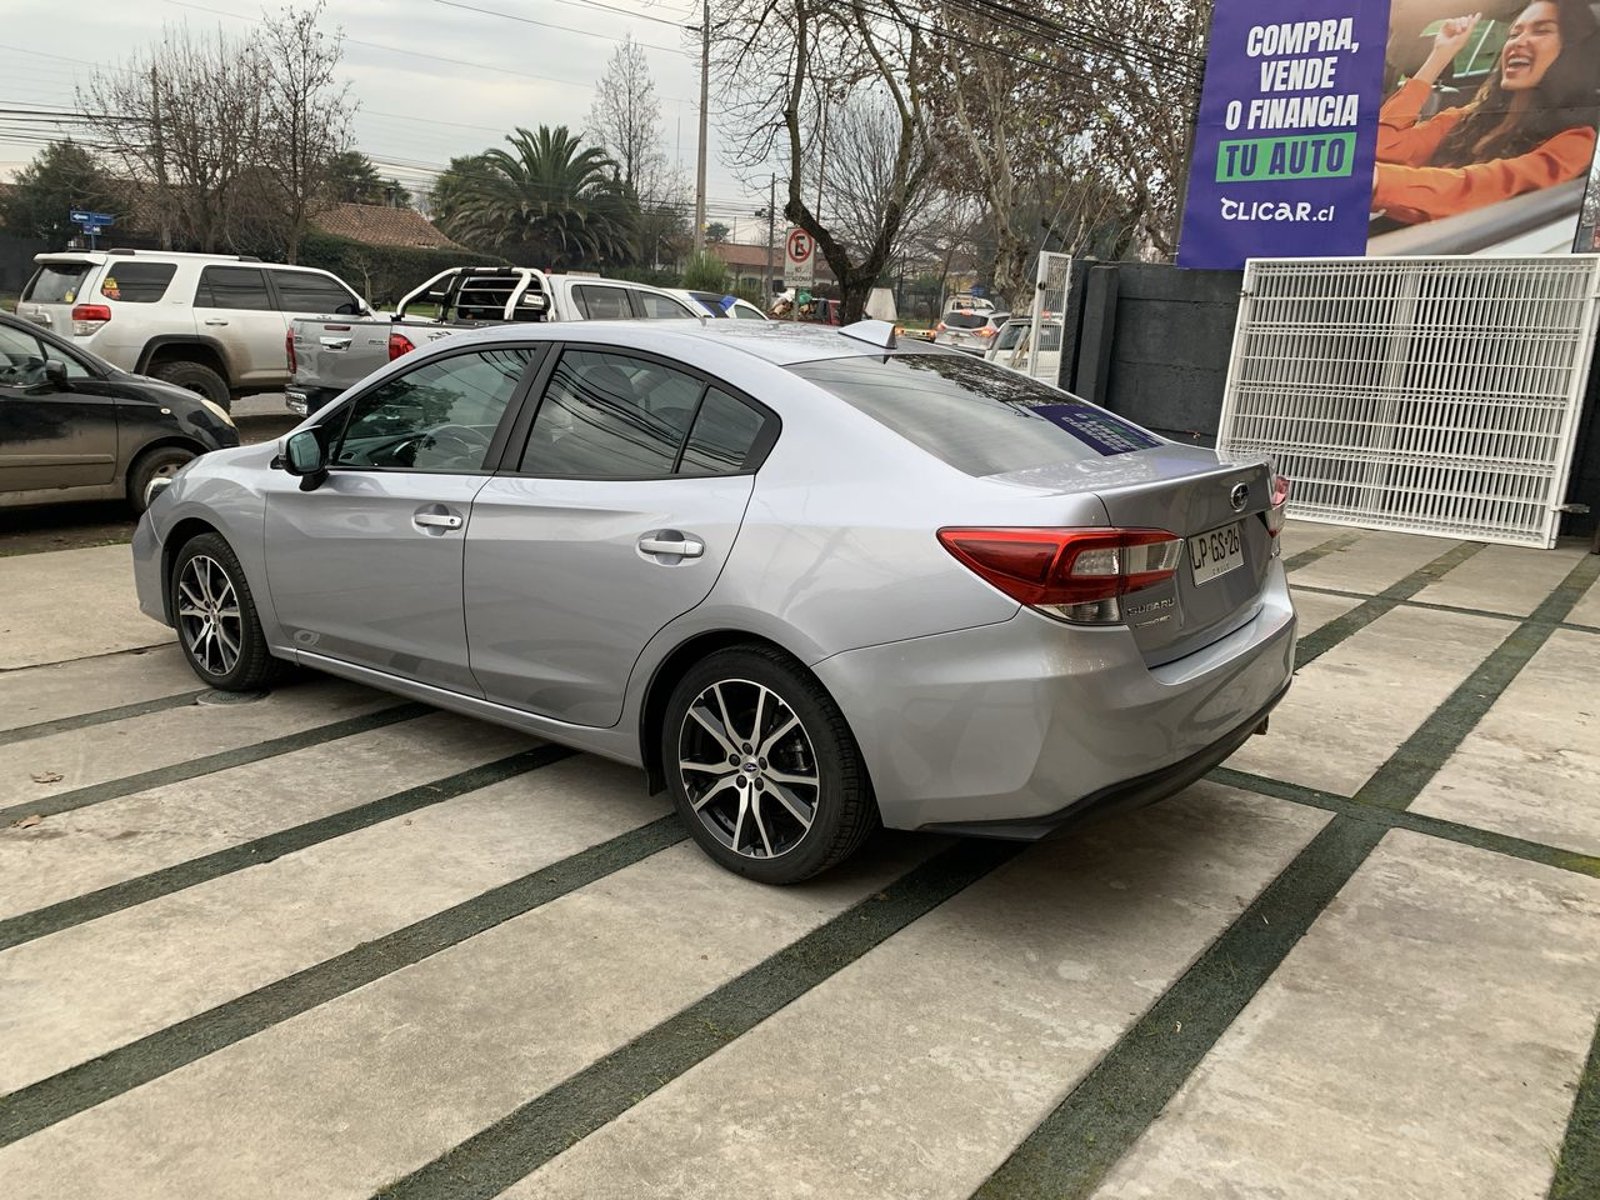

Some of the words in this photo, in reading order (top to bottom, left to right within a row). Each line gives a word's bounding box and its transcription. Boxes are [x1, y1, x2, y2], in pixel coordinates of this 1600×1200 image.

[1246, 18, 1359, 57] COMPRA,
[1260, 57, 1337, 91] VENDE
[1225, 100, 1242, 130] O
[1247, 94, 1358, 130] FINANCIA
[1225, 143, 1258, 177] TU
[1268, 138, 1346, 175] AUTO
